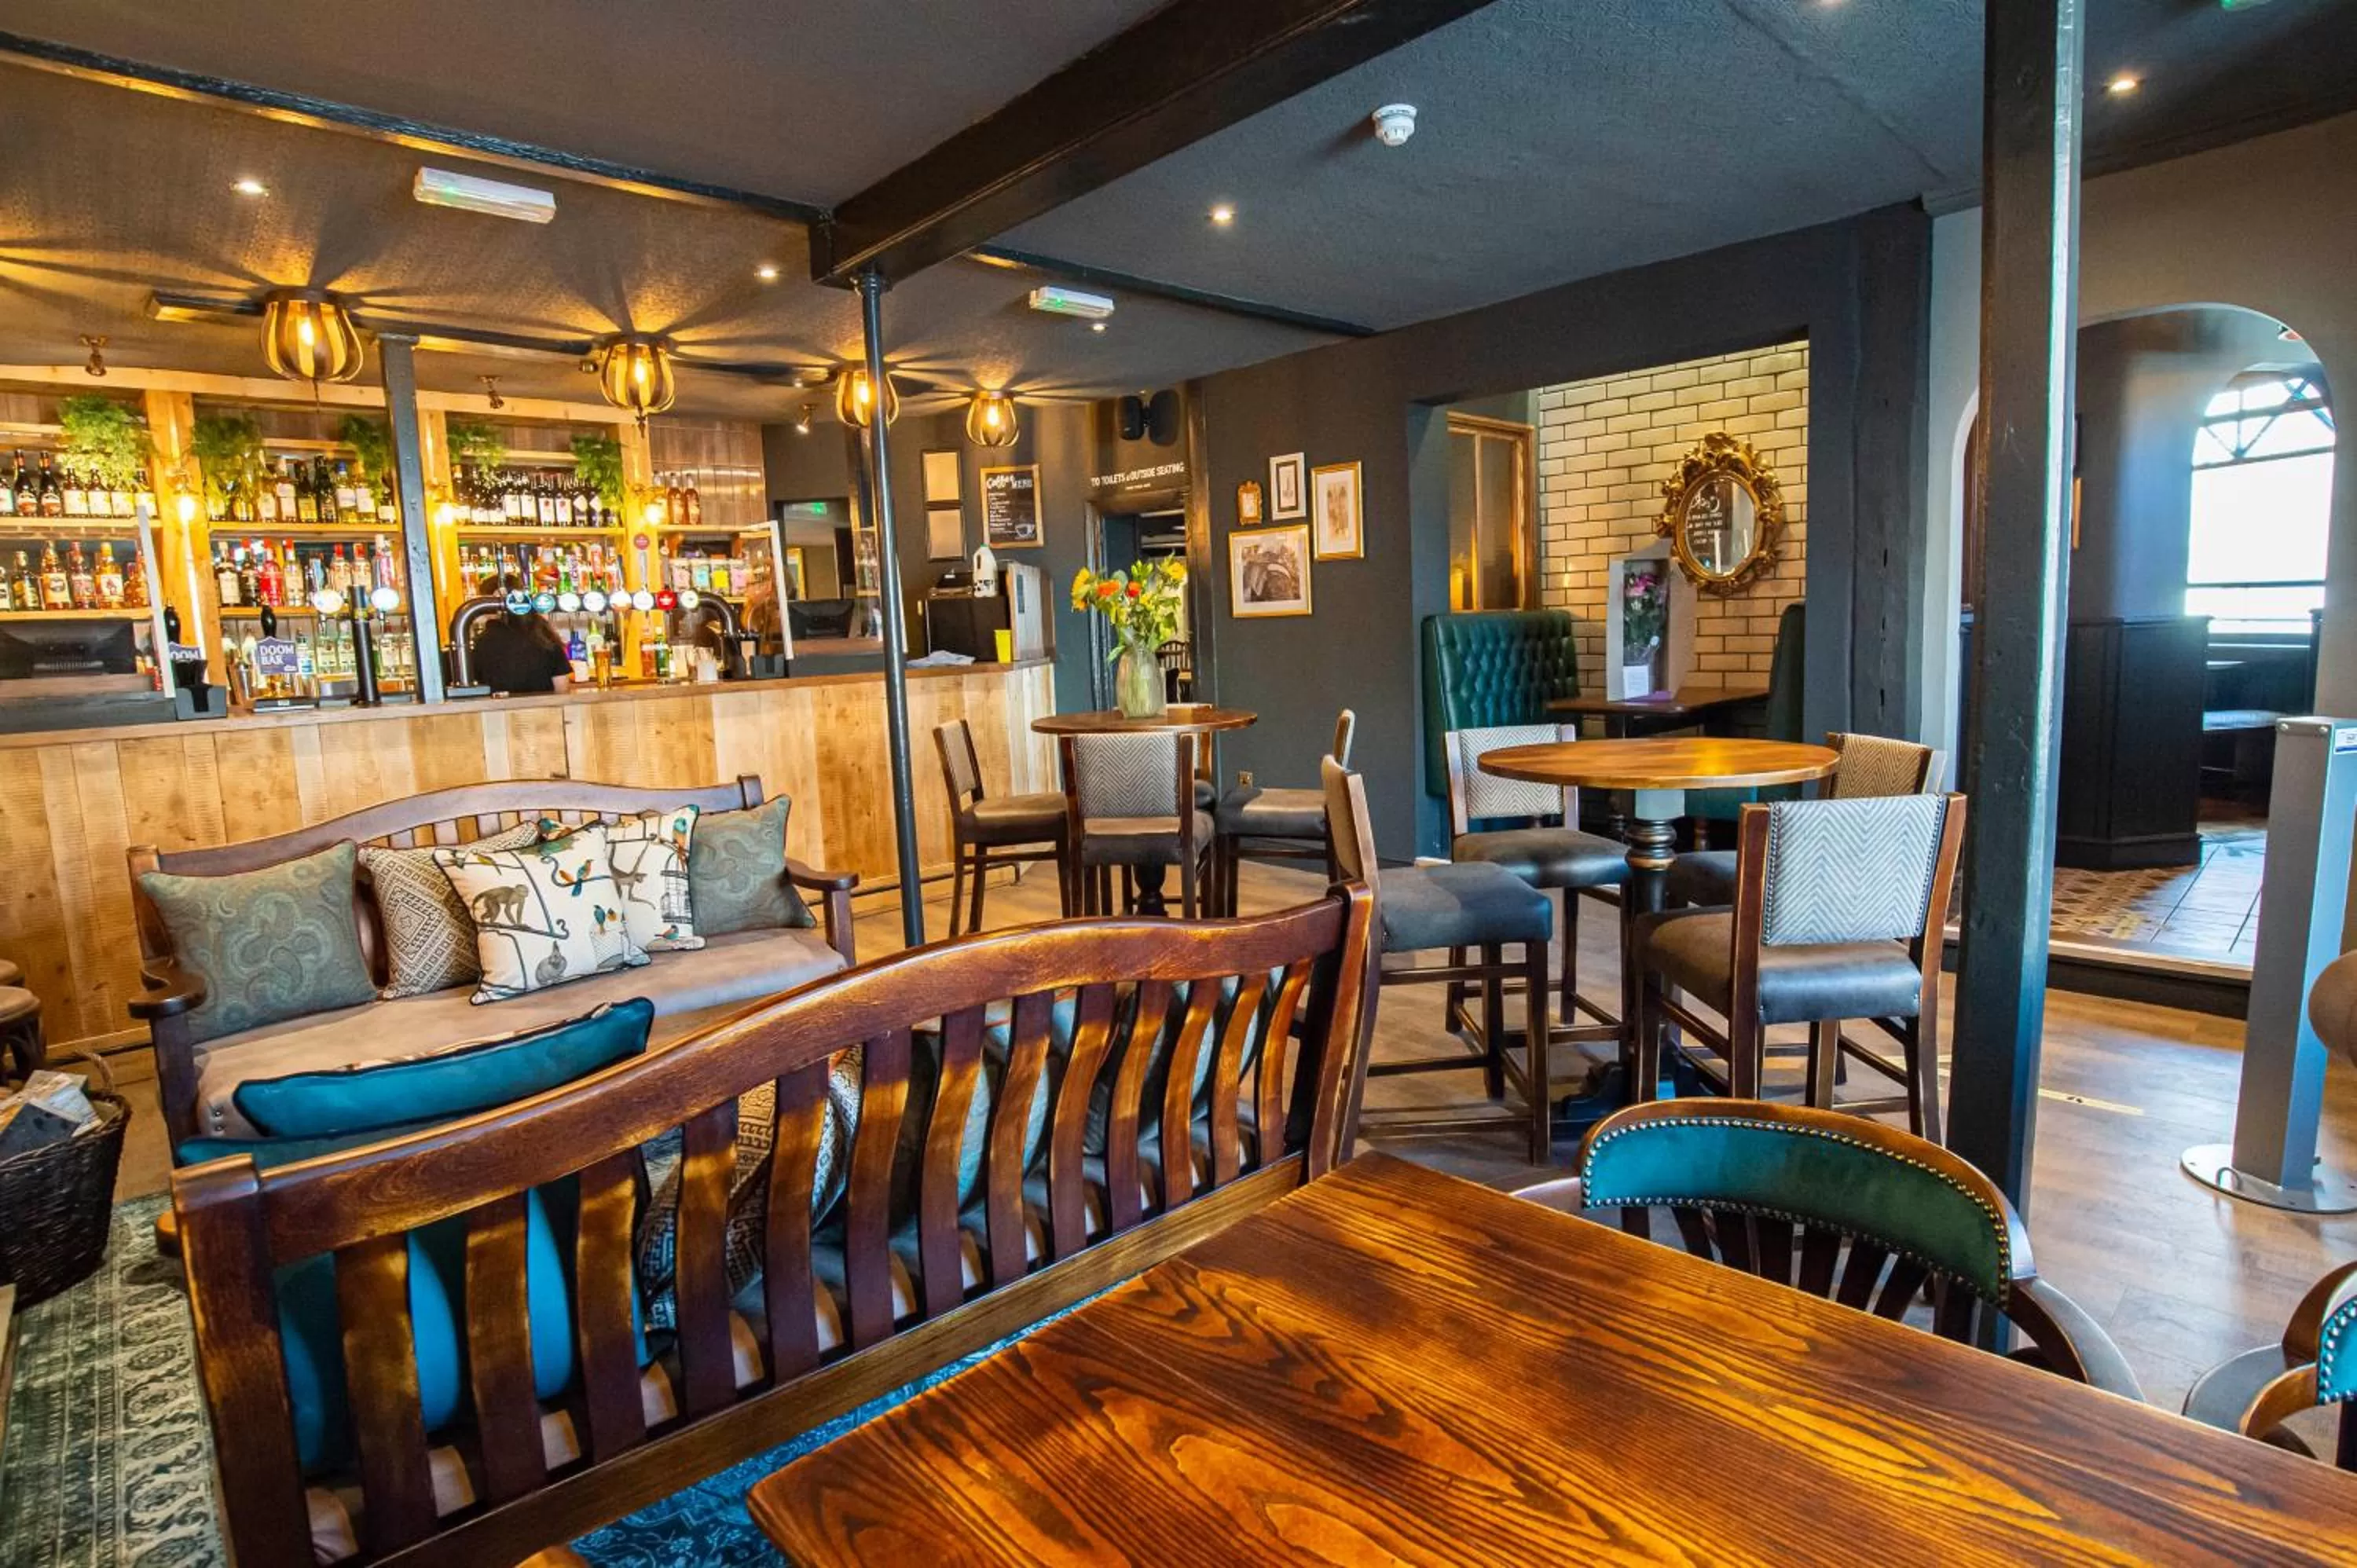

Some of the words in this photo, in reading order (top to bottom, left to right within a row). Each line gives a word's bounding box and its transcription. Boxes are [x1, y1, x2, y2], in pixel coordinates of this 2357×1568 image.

[1091, 477, 1100, 486] TO
[1102, 473, 1125, 485] TOILETS
[1131, 467, 1156, 481] OUTSIDE
[1157, 461, 1185, 476] SEATING
[259, 644, 295, 655] DOOM
[170, 650, 198, 661] OOM
[261, 655, 284, 666] BAR
